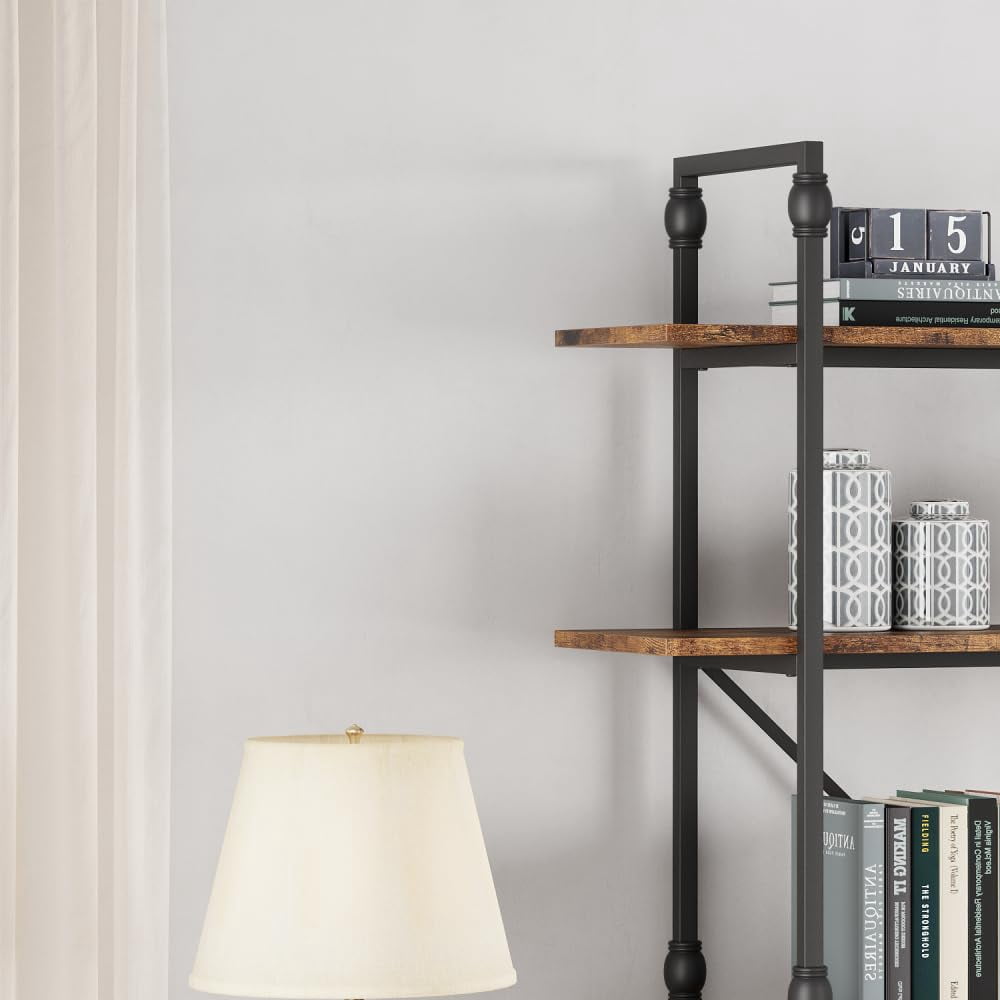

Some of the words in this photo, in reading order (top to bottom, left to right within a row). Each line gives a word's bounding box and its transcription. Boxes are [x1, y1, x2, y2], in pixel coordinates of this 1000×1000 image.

[889, 212, 905, 251] 1
[947, 215, 967, 254] 5
[888, 261, 971, 274] JANUARY
[895, 316, 933, 324] Architecture
[935, 316, 969, 325] Residential
[950, 815, 959, 824] The
[948, 825, 959, 842] Poetry
[948, 849, 959, 862] Yoga
[921, 903, 929, 959] STRONGHOLD
[950, 981, 959, 999] Edited
